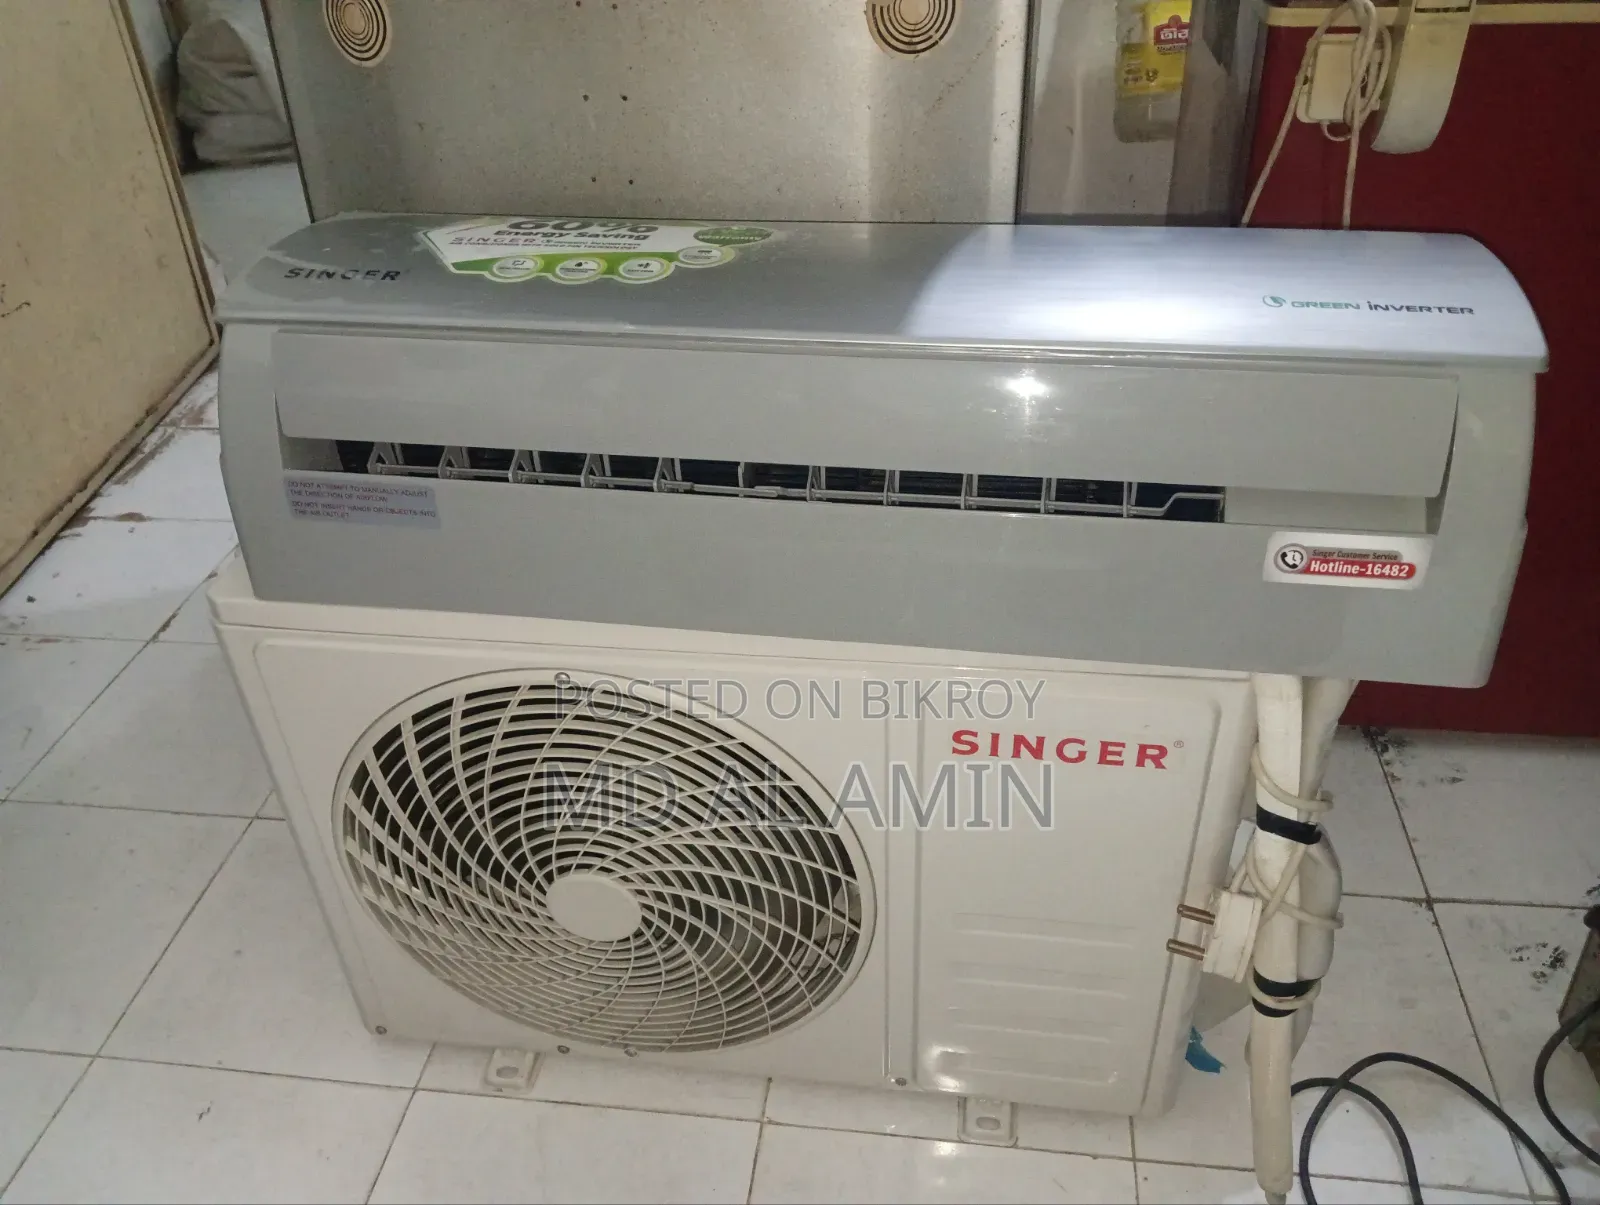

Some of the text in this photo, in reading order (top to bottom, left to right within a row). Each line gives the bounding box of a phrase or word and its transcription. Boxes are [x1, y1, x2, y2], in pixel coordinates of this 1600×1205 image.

[494, 230, 650, 241] Energy Saving
[1291, 301, 1361, 310] GREEN
[1312, 549, 1398, 561] Singer Customer Service
[1310, 560, 1409, 577] Hotline-16482
